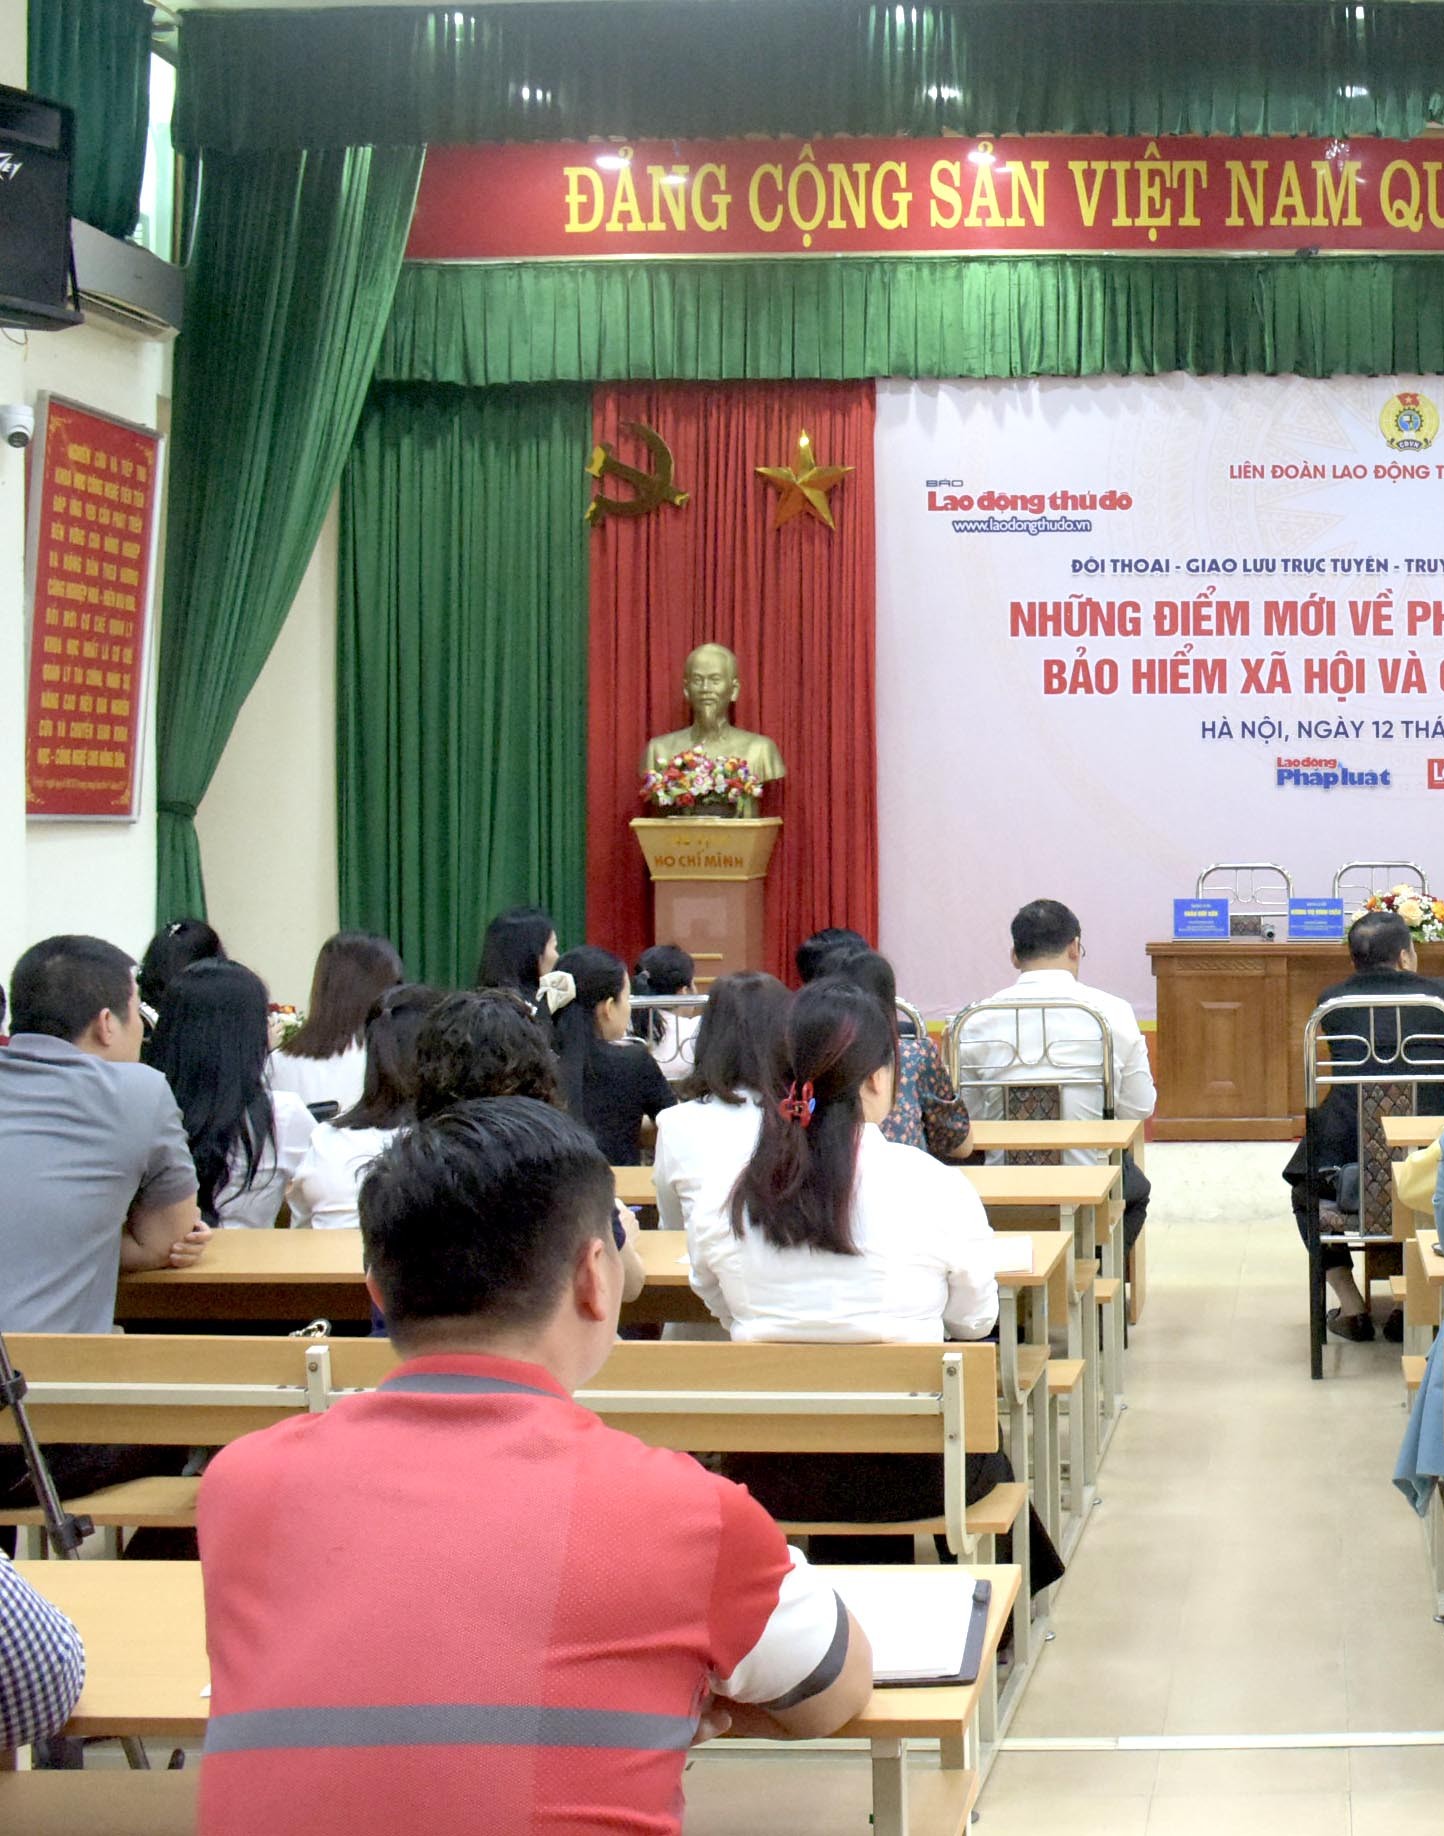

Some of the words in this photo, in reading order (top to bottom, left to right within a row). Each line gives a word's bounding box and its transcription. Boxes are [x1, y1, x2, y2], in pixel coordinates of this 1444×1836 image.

[563, 145, 732, 233] ĐẢNG
[749, 143, 913, 248] CỘNG
[930, 141, 1049, 229] SẢN
[1068, 141, 1207, 242] VIỆT
[1225, 161, 1362, 227] NAM
[1229, 459, 1264, 479] LIÊN
[1270, 459, 1326, 480] ĐOÀN
[1332, 464, 1368, 480] LAO
[1373, 460, 1430, 484] ĐỘNG
[928, 491, 974, 511] Lao
[977, 490, 1045, 515] động
[953, 516, 1092, 536] www.laodongthudo.vn
[1186, 558, 1237, 573] GIAO
[1243, 558, 1276, 573] LƯU
[1281, 558, 1326, 574] TRỰC
[1010, 593, 1141, 637] NHỮNG
[1153, 585, 1250, 637] ĐIỂM
[1264, 593, 1336, 637] MỚI
[1348, 588, 1393, 637] VỀ
[1043, 646, 1118, 695] BẢO
[1132, 643, 1227, 694] HIỂM
[1240, 650, 1292, 694] XÃ
[1304, 650, 1365, 703] HỘI
[1379, 650, 1427, 694] VÀ
[1201, 716, 1233, 739] HÀ
[1241, 717, 1289, 744] NỘI,
[1298, 716, 1365, 739] NGÀY
[1373, 722, 1394, 739] 12
[1277, 768, 1339, 788] Pháp
